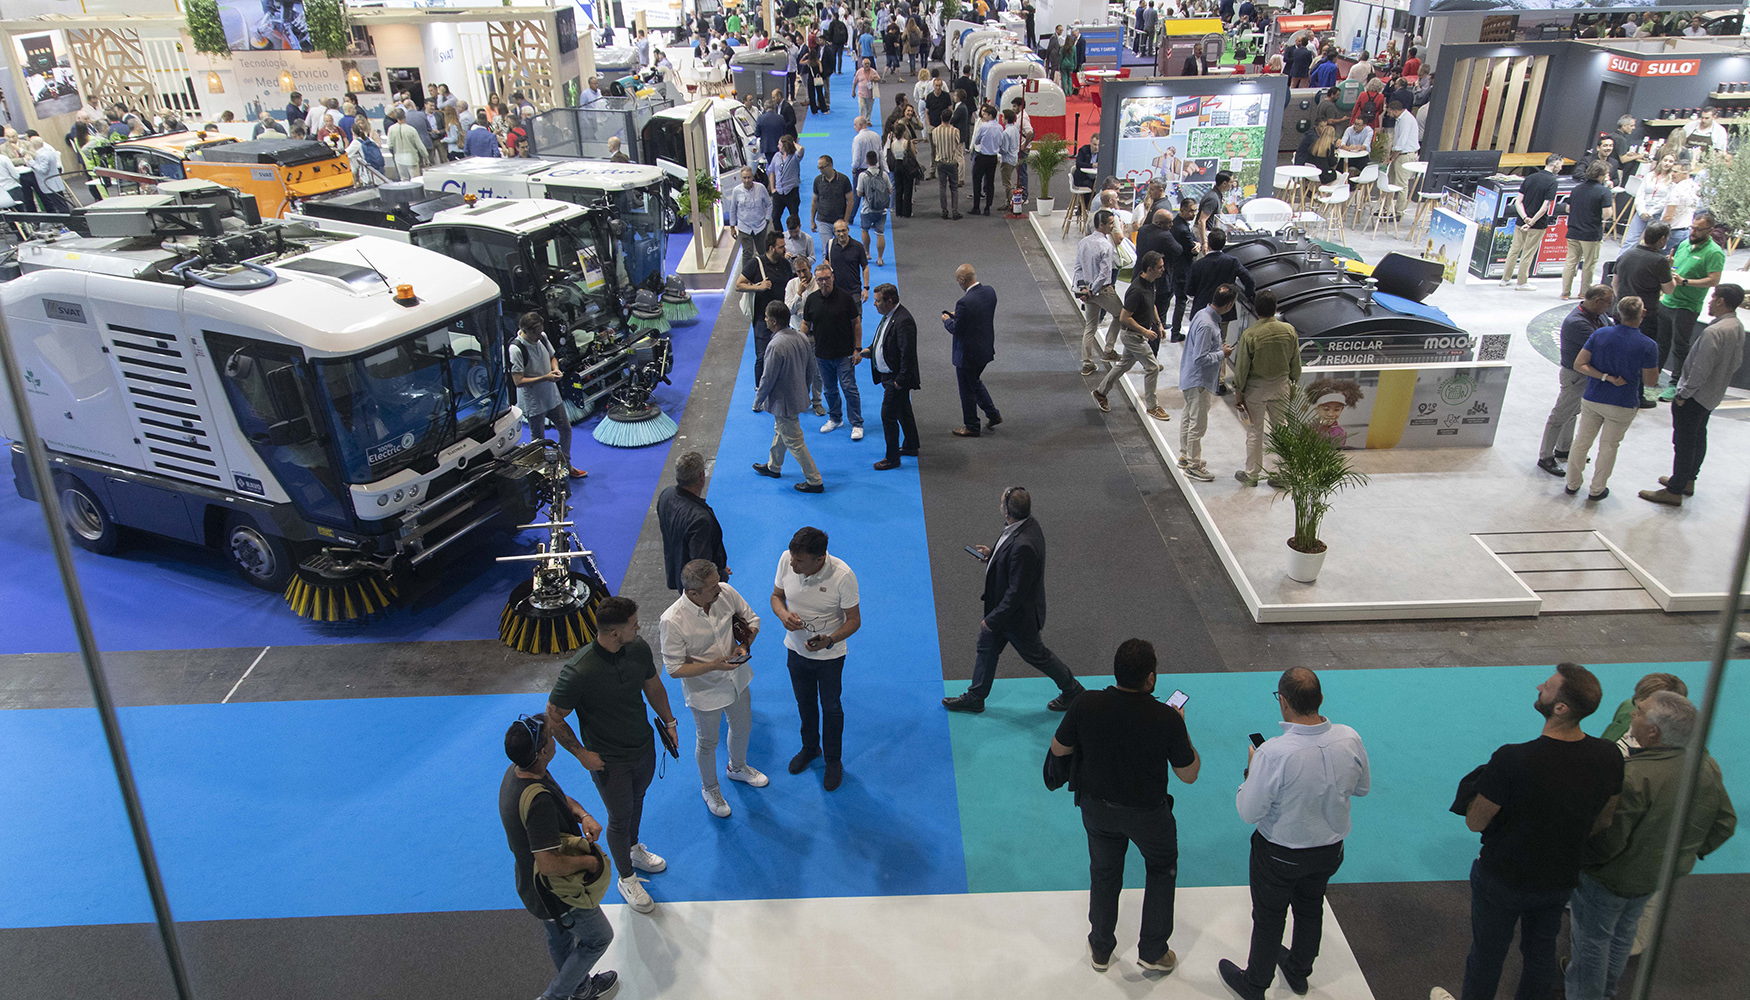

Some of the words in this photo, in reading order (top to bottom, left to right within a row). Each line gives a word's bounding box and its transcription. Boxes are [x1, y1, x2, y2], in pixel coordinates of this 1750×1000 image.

[440, 49, 454, 62] SVAT
[1611, 58, 1638, 73] SULO
[1646, 62, 1694, 74] SULO
[292, 68, 328, 80] ervicio
[58, 306, 80, 316] SVAT
[1328, 341, 1383, 351] RECICLAR
[1326, 354, 1375, 364] REDUCIR
[368, 445, 401, 463] Electric
[377, 443, 393, 453] 100%
